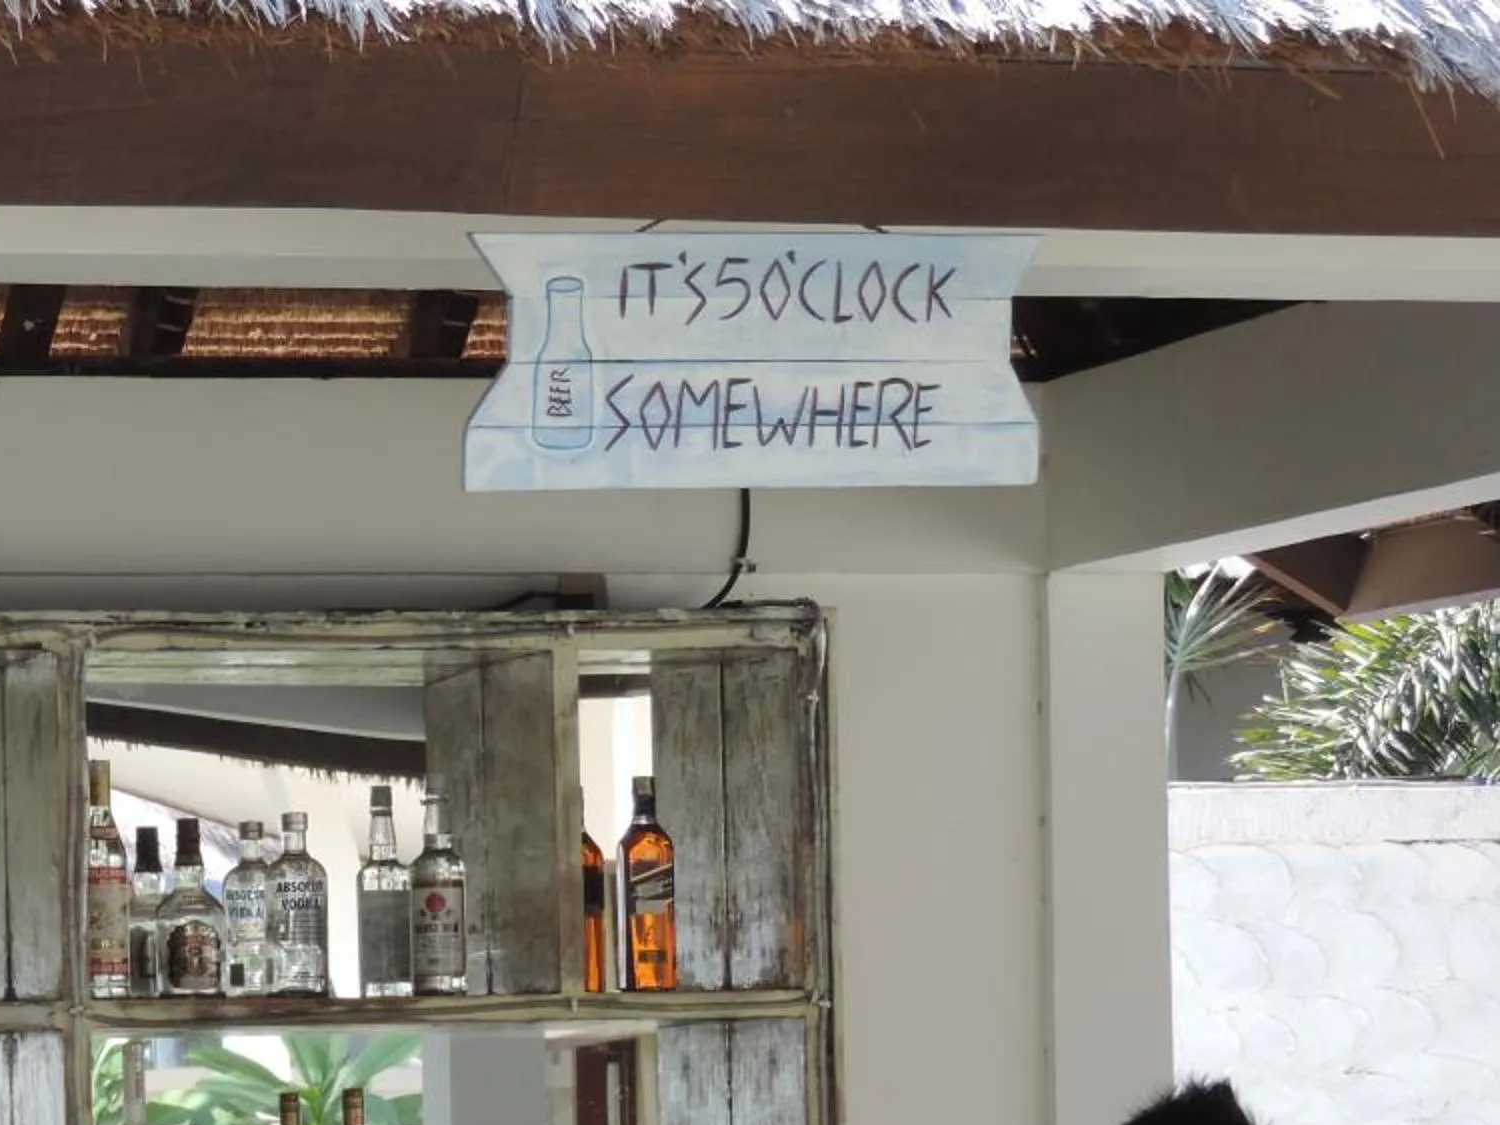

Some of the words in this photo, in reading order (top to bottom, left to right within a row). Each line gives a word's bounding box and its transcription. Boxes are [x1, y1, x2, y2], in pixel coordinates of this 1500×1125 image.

[619, 251, 707, 326] IT'S
[715, 256, 752, 320] 5
[759, 249, 957, 324] O'CLOCK
[546, 366, 575, 419] BEER
[604, 372, 942, 453] SOMEWHERE
